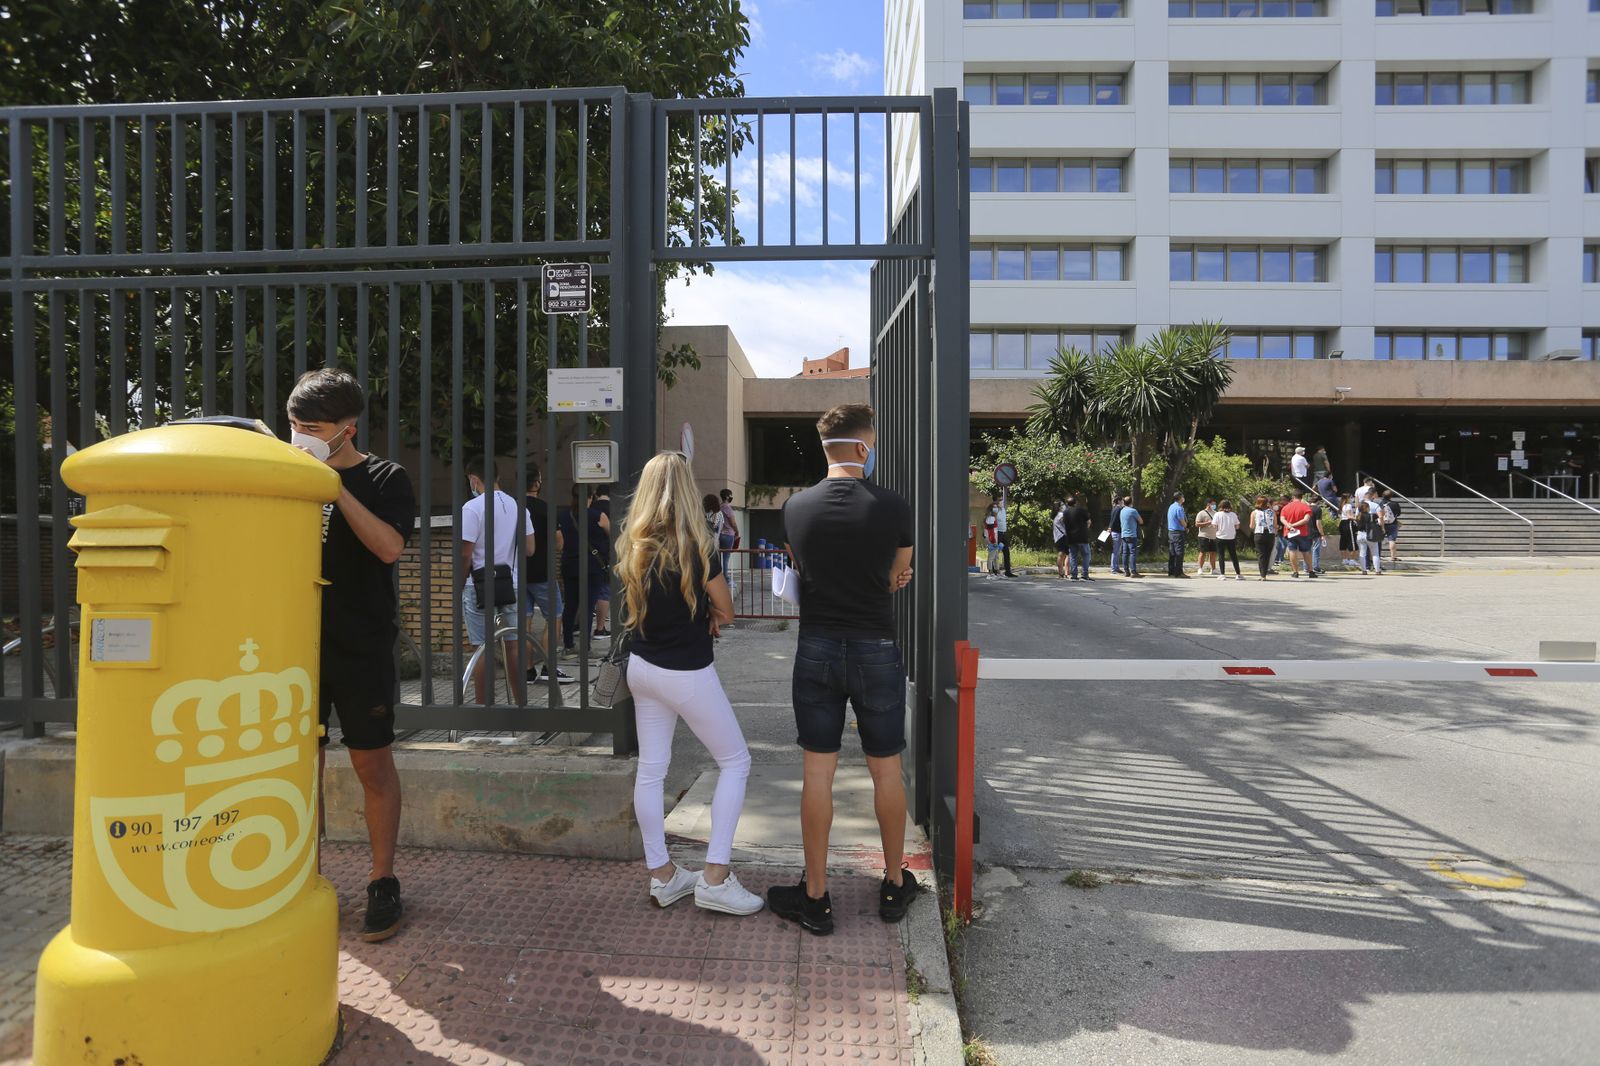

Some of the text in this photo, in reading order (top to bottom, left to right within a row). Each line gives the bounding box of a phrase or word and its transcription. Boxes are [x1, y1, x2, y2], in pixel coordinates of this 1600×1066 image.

[131, 810, 240, 836] 90 197 197
